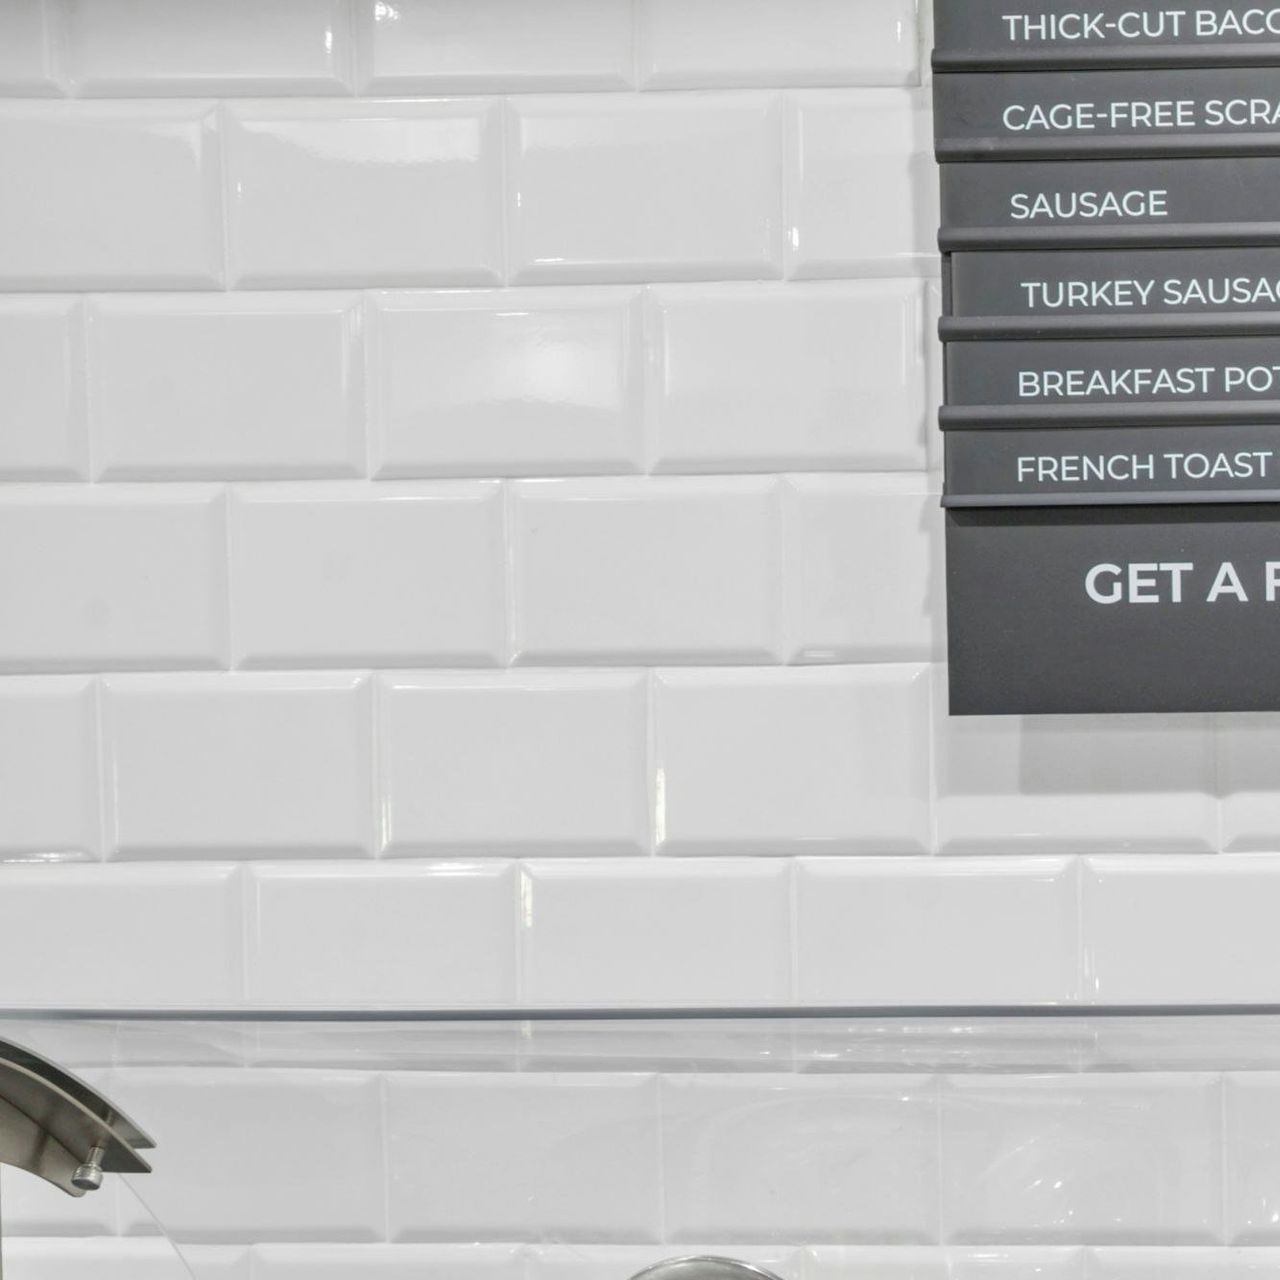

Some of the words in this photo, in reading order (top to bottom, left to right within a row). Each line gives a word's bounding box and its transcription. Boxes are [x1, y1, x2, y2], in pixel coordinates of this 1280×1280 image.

[1002, 11, 1186, 40] THICK-CUT
[1003, 101, 1195, 130] CAGE-FREE
[1011, 190, 1167, 218] SAUSAGE
[1021, 280, 1154, 307] TURKEY
[1019, 368, 1215, 396] BREAKFAST
[1018, 455, 1153, 481] FRENCH
[1164, 452, 1272, 478] TOAST
[1086, 563, 1193, 604] GET
[1207, 562, 1248, 601] A
